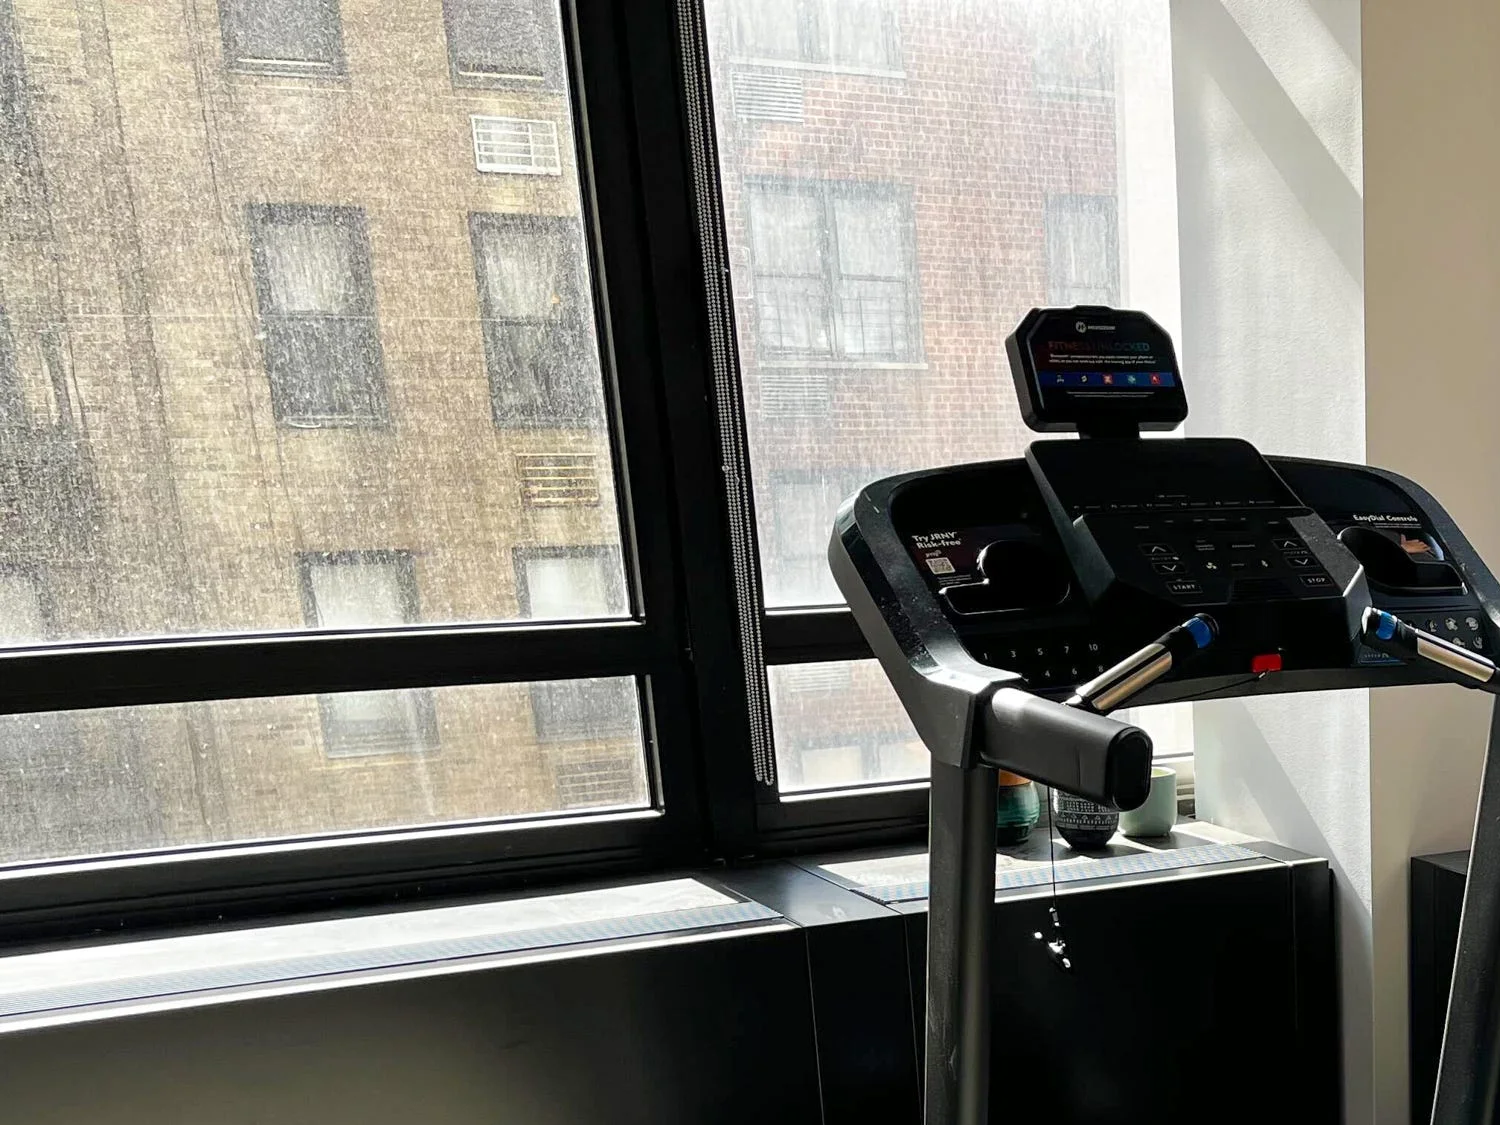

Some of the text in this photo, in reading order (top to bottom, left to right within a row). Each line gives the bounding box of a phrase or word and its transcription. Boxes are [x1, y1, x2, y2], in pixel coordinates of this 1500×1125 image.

[1352, 514, 1419, 523] EasyDial Controls
[911, 531, 957, 543] Try JRNY
[916, 539, 962, 550] Risk-free
[1088, 643, 1099, 652] 10
